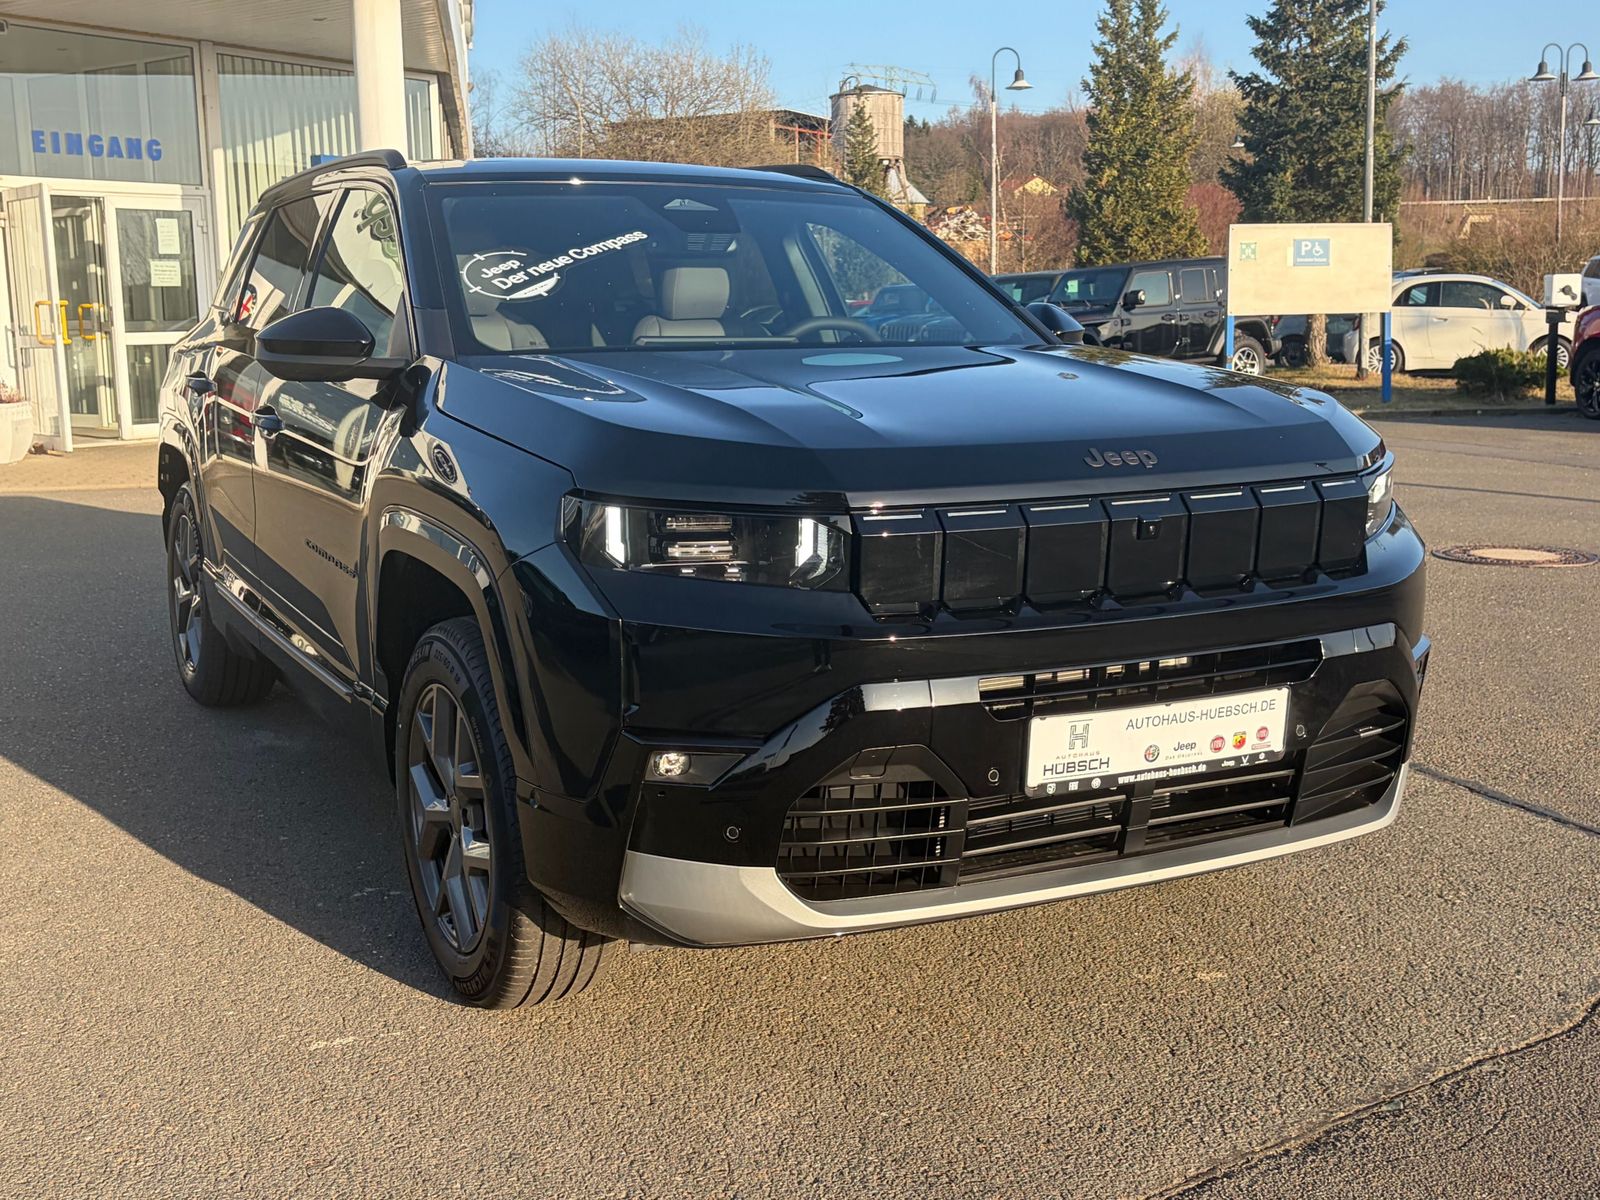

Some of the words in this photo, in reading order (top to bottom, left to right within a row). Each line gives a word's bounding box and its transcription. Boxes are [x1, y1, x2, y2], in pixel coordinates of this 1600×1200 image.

[31, 130, 162, 161] EINGANG
[1301, 240, 1312, 256] P
[490, 271, 530, 290] Der
[526, 255, 574, 277] neue
[568, 231, 648, 260] Compass
[1083, 447, 1158, 469] Jeep
[1125, 699, 1277, 731] AUTOHAUS-HUEBSCH.DE
[1055, 750, 1101, 760] AUTOHAUS
[1173, 741, 1197, 752] Jeep
[1043, 757, 1110, 777] HÜBSCH
[1117, 763, 1207, 784] www.autohaus-huebsch.de
